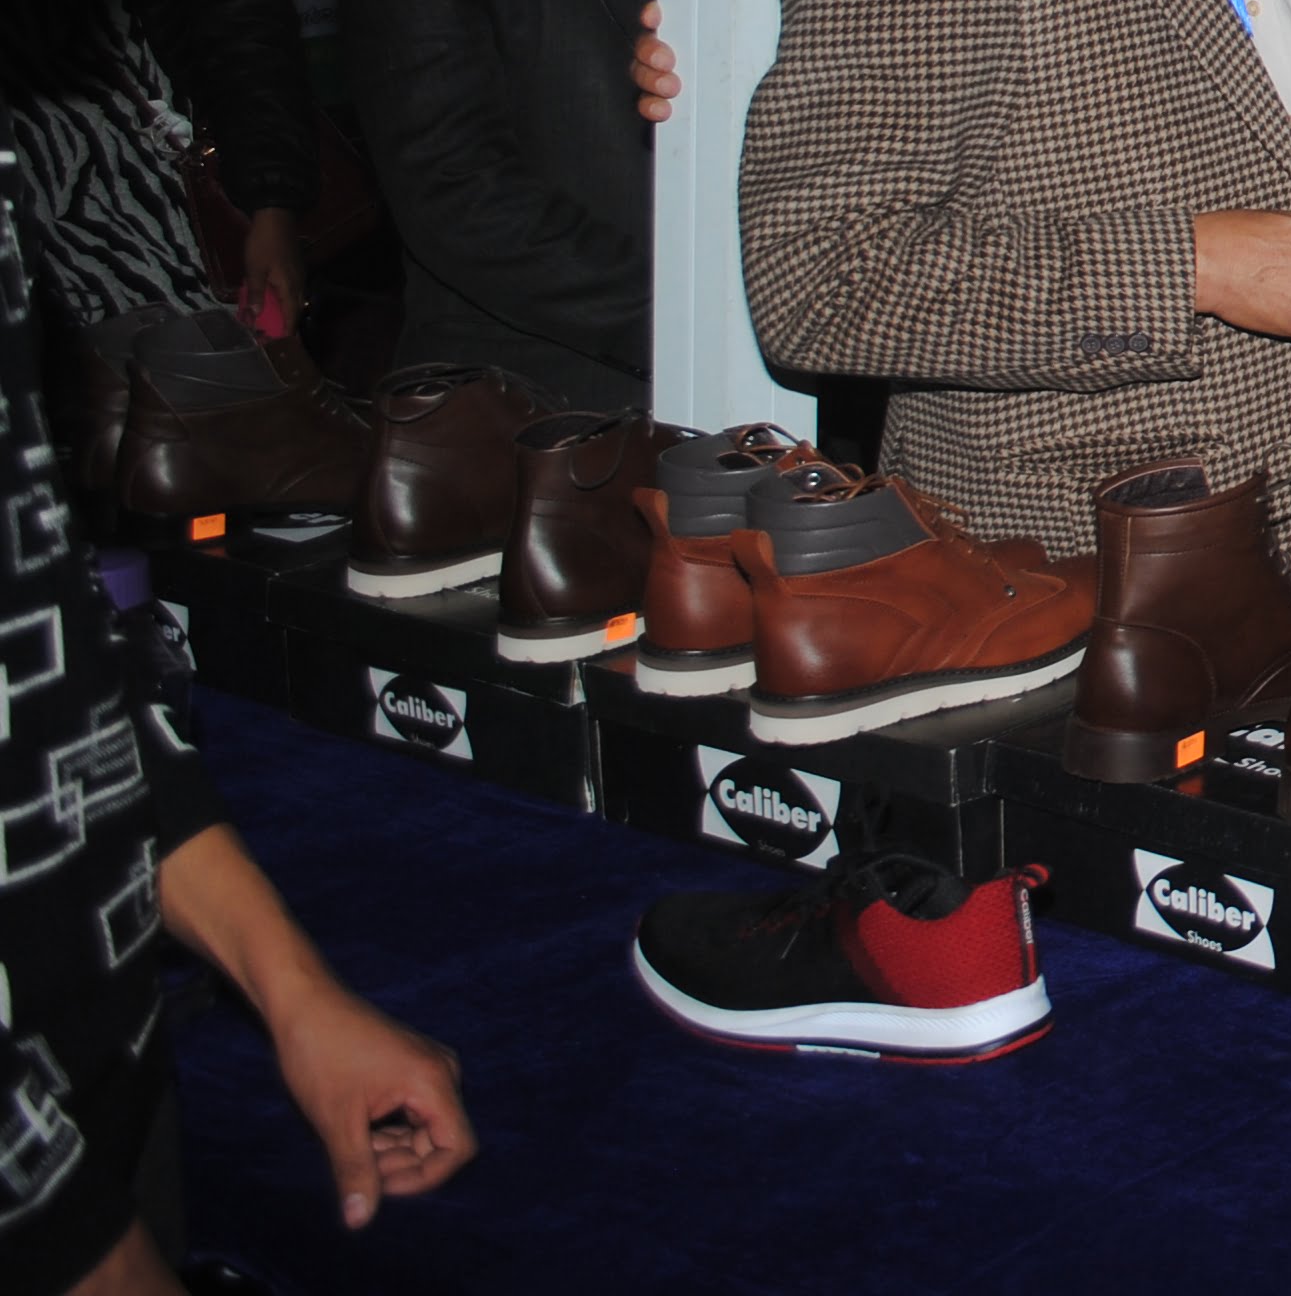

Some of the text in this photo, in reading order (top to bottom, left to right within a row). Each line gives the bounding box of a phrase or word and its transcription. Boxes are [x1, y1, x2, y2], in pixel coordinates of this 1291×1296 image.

[381, 690, 458, 730] Caliber
[715, 776, 822, 835] Caliber
[1152, 877, 1257, 935] Caliber
[1185, 929, 1225, 954] Shoes
